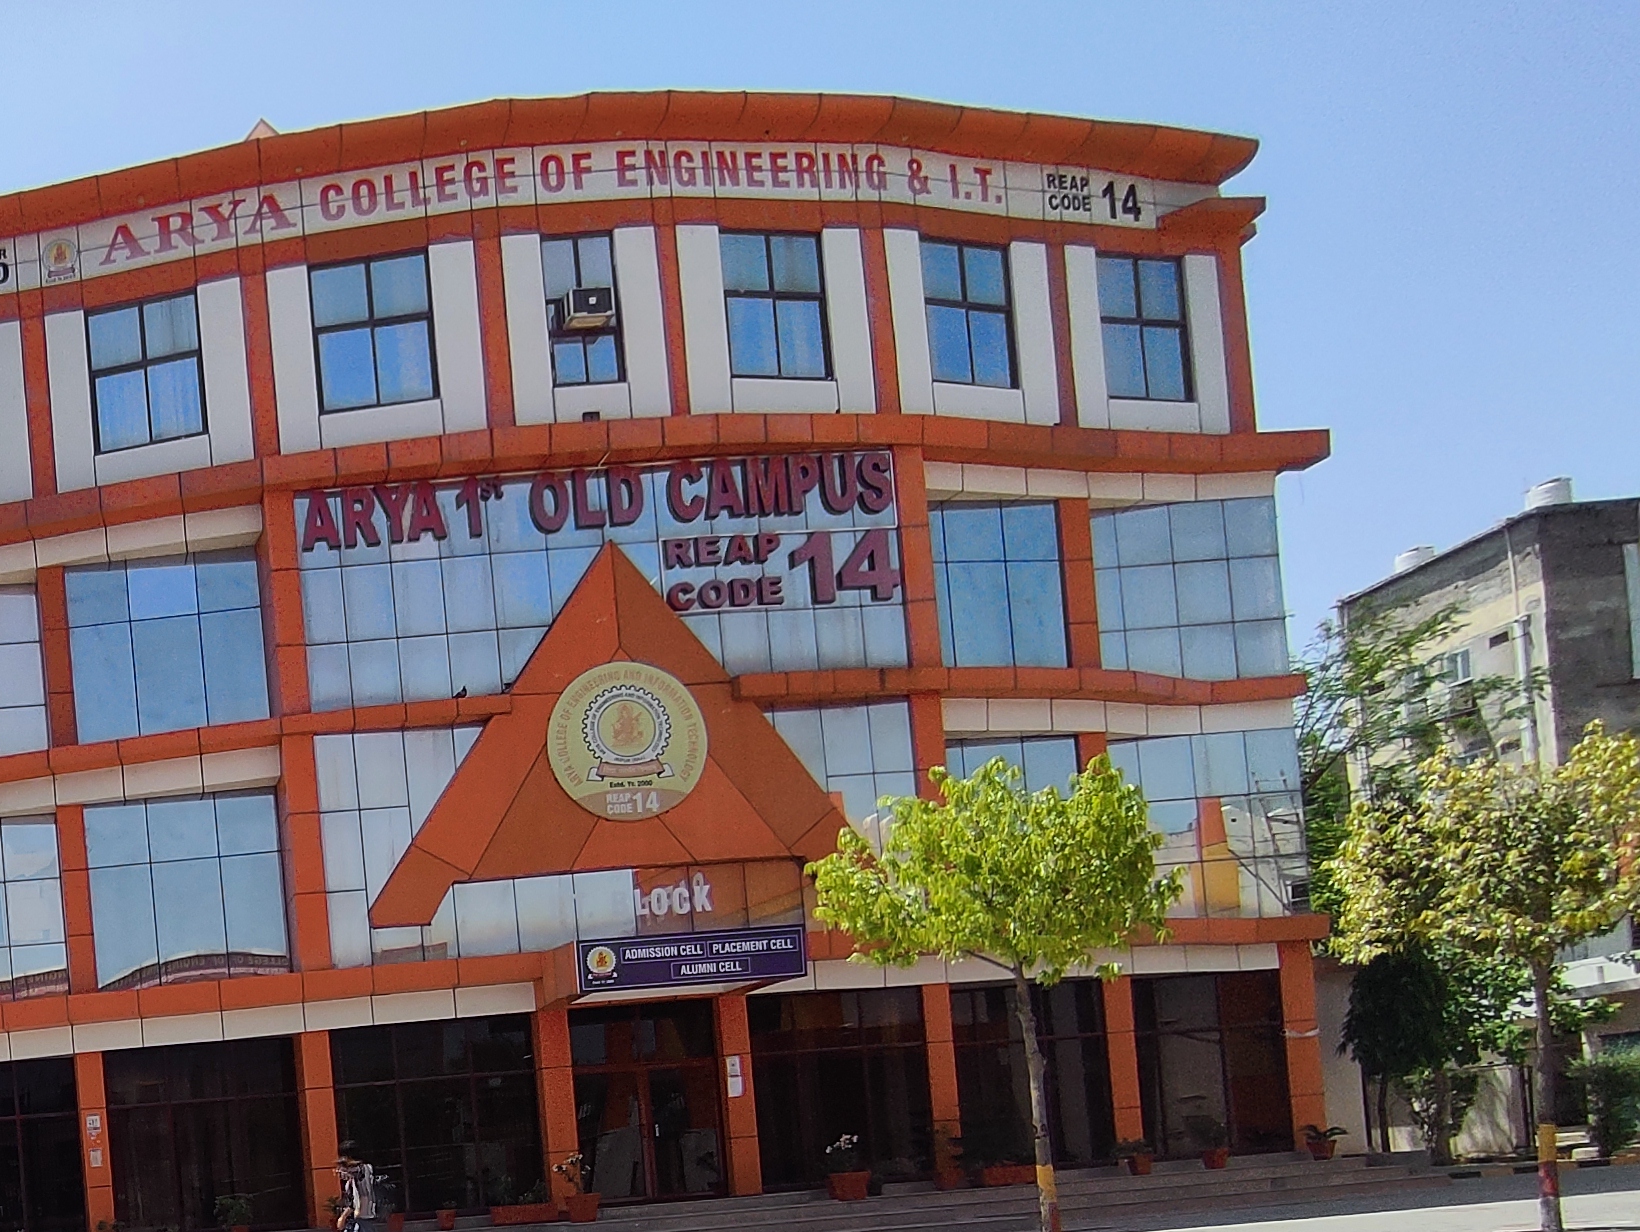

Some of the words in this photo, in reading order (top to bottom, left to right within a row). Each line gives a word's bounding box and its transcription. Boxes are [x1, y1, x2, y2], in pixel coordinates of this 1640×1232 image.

[1046, 173, 1089, 193] REAP
[99, 193, 297, 267] ARYA
[320, 155, 519, 222] COLLEGE
[540, 152, 593, 193] OF
[616, 150, 887, 191] ENGINEERING
[907, 158, 932, 195] &
[949, 164, 1002, 203] I.T.
[1048, 193, 1091, 212] CODE
[1102, 181, 1142, 222] 14
[302, 481, 447, 552] ARYA
[455, 475, 503, 539] 1st
[528, 465, 644, 534] OLD
[666, 453, 893, 523] CAMPUS
[664, 532, 781, 570] REAP
[788, 528, 901, 605] 14
[666, 576, 784, 612] CODE
[569, 670, 621, 709] ENGINEERING
[623, 669, 642, 680] AND
[643, 673, 693, 720] INFORMATION
[679, 722, 700, 782] TECHNOLOGY
[606, 803, 633, 815] CODE
[632, 791, 660, 813] 14
[624, 946, 678, 960] ADMISSION
[679, 944, 703, 957] CELL
[712, 940, 768, 954] PLACEMENT
[770, 938, 793, 950] CELL
[680, 963, 717, 975] ALUMNI
[719, 961, 742, 973] CELL
